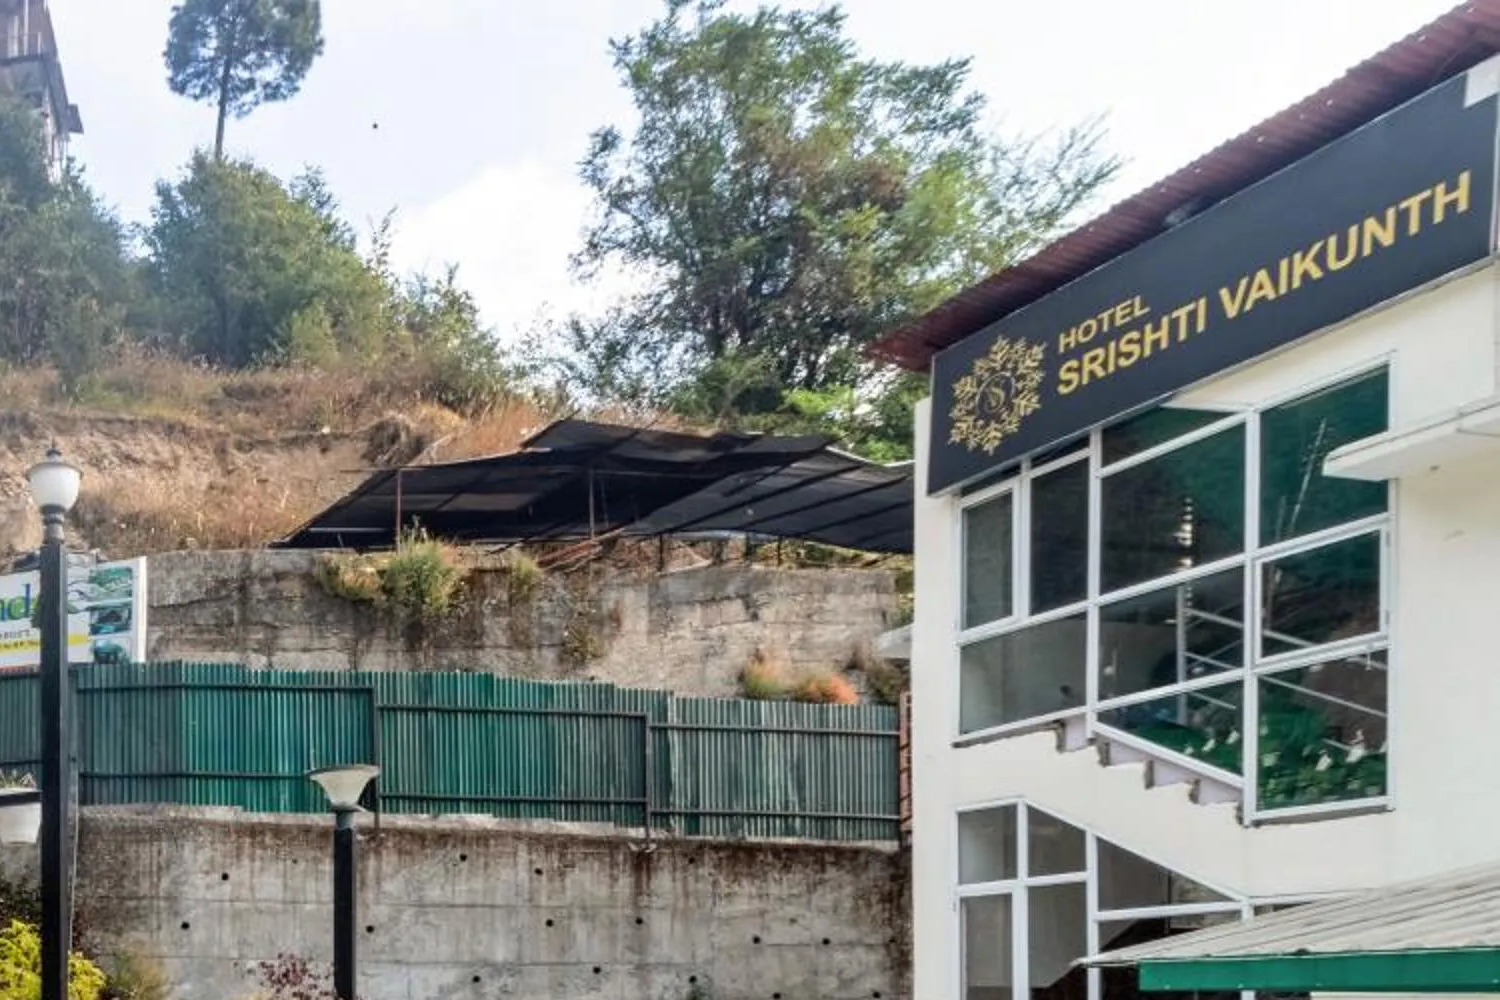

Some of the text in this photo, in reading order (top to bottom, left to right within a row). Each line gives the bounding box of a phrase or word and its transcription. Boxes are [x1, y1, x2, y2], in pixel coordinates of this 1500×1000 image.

[1056, 170, 1472, 396] SRISHTI VAIKUNTH
[1057, 295, 1150, 355] HOTEL
